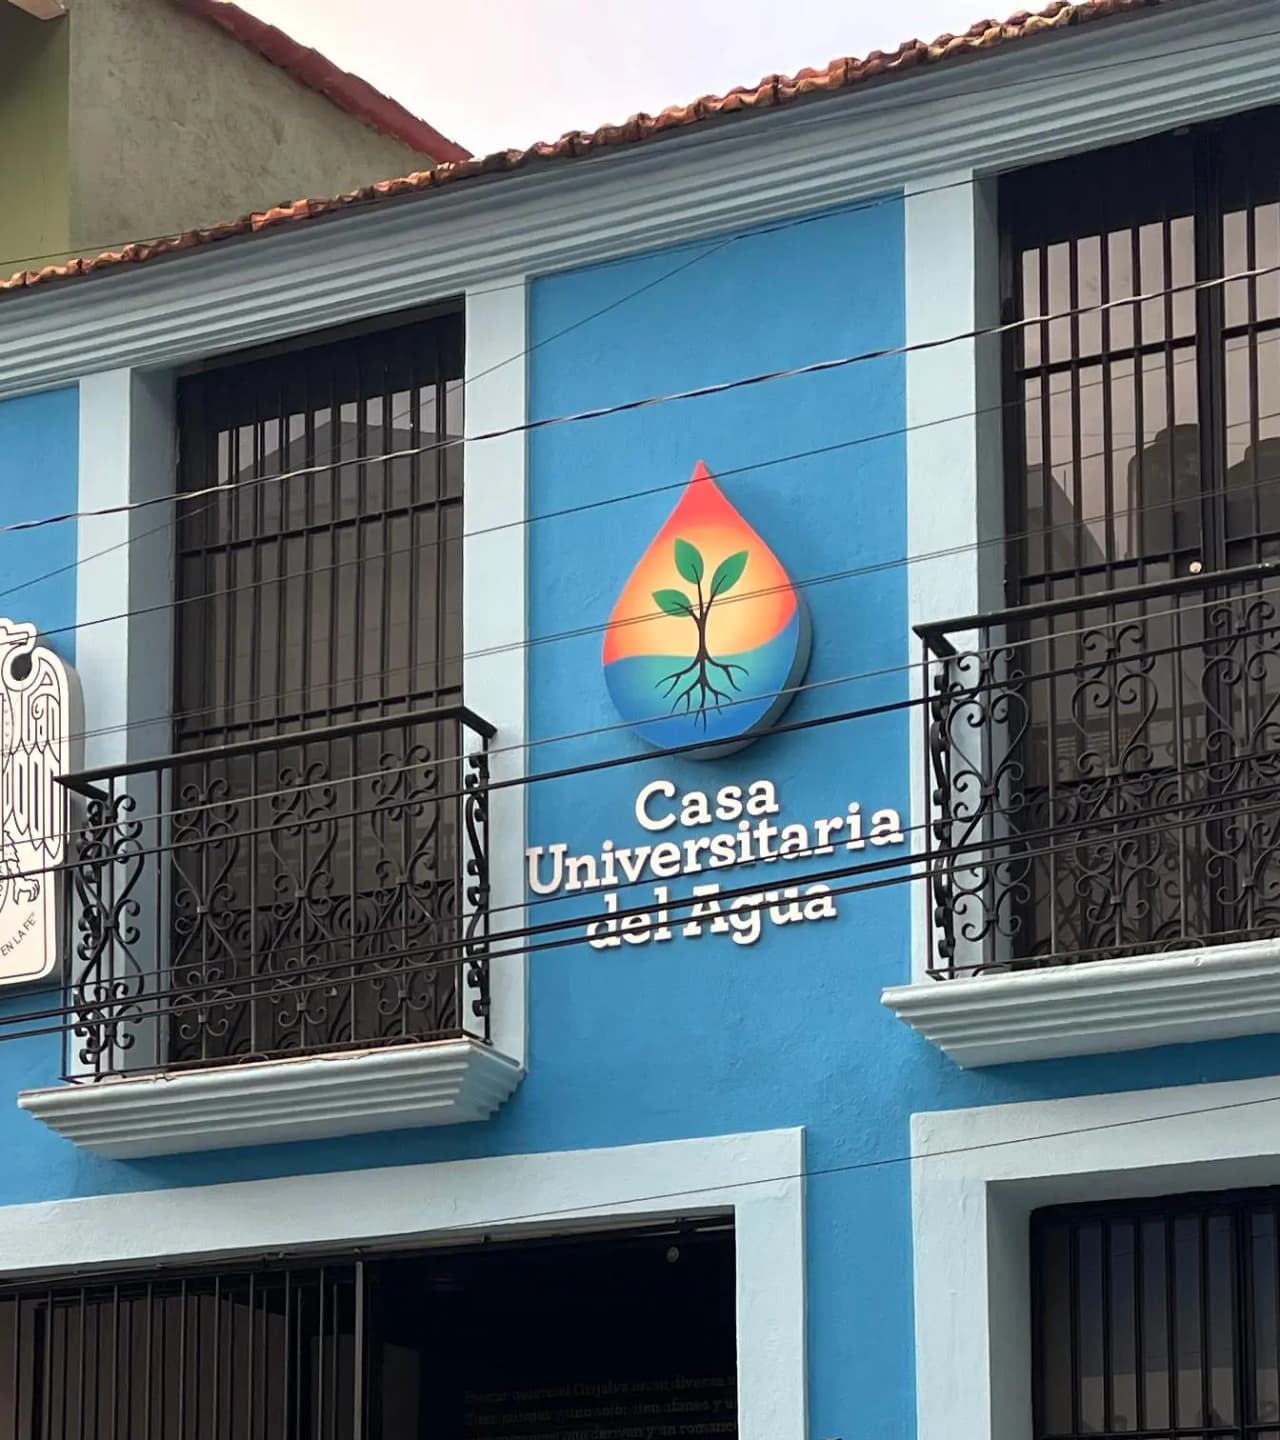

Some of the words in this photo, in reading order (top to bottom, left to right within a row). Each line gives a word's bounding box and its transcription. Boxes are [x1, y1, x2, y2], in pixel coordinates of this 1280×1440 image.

[635, 780, 779, 831] Casa
[526, 802, 905, 895] Universitaria
[0, 942, 15, 957] EN
[13, 929, 26, 944] LA
[586, 886, 672, 949] del
[682, 882, 837, 945] Agua
